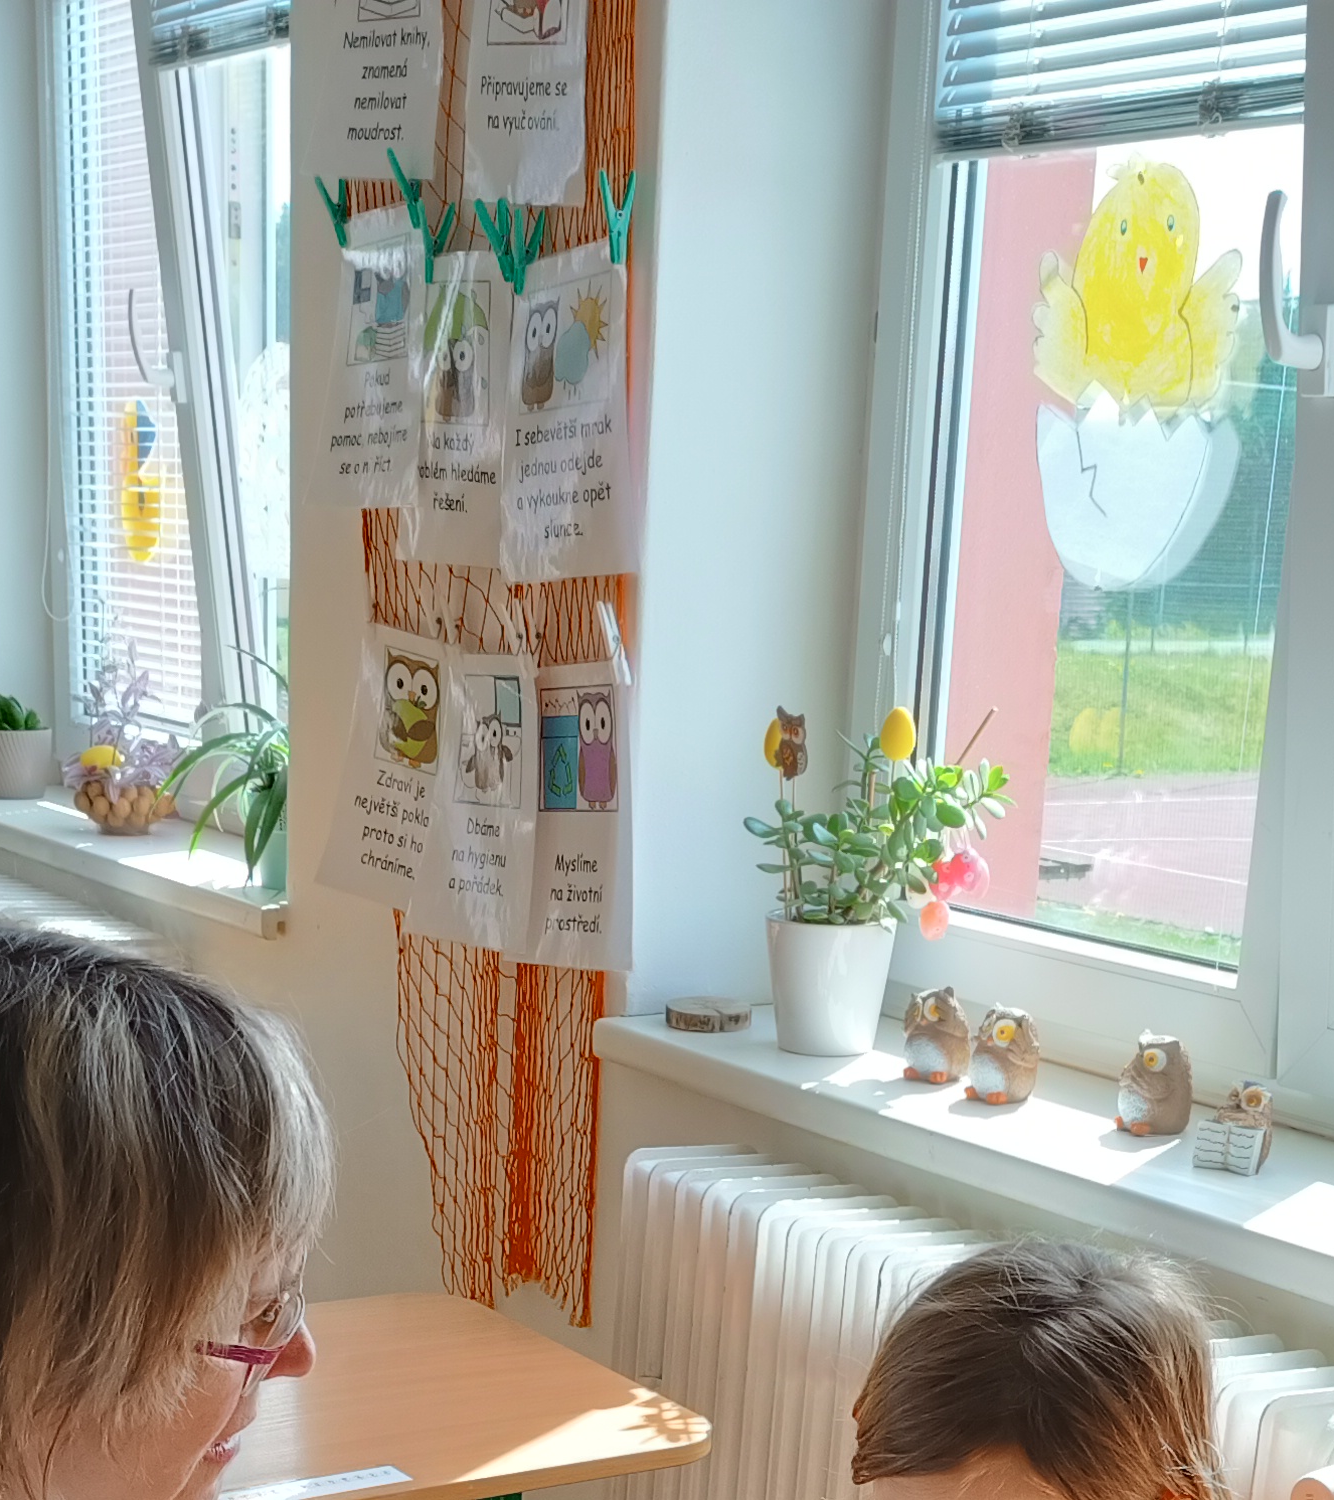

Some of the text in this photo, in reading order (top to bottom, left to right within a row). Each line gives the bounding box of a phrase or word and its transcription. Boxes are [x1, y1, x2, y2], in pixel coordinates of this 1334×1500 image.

[343, 26, 430, 49] Nemilovat knihy,
[361, 58, 408, 80] znamená
[480, 75, 568, 102] Připravujeme se
[354, 92, 407, 111] nemilovat
[347, 122, 404, 142] moudrost.
[487, 109, 560, 135] na vyučování.
[367, 426, 408, 448] nebojíme
[515, 413, 612, 447] I sebevětší mrak
[443, 432, 476, 455] každý
[339, 462, 350, 475] se
[353, 463, 360, 475] o
[451, 462, 496, 484] hledáme
[519, 448, 603, 484] jednou odejde
[433, 491, 467, 513] řešení.
[517, 480, 611, 514] a vykoukne opět
[544, 518, 583, 539] slunce.
[377, 769, 426, 802] Zdraví je
[401, 808, 430, 828] pokla
[467, 817, 500, 838] Dbáme
[362, 825, 424, 854] proto si ho
[360, 848, 415, 880] chráníme.
[452, 845, 507, 870] na hygienu
[554, 853, 598, 877] Myslíme
[448, 875, 504, 897] a pořádek.
[550, 883, 603, 903] na životní
[544, 913, 602, 935] prostředí.
